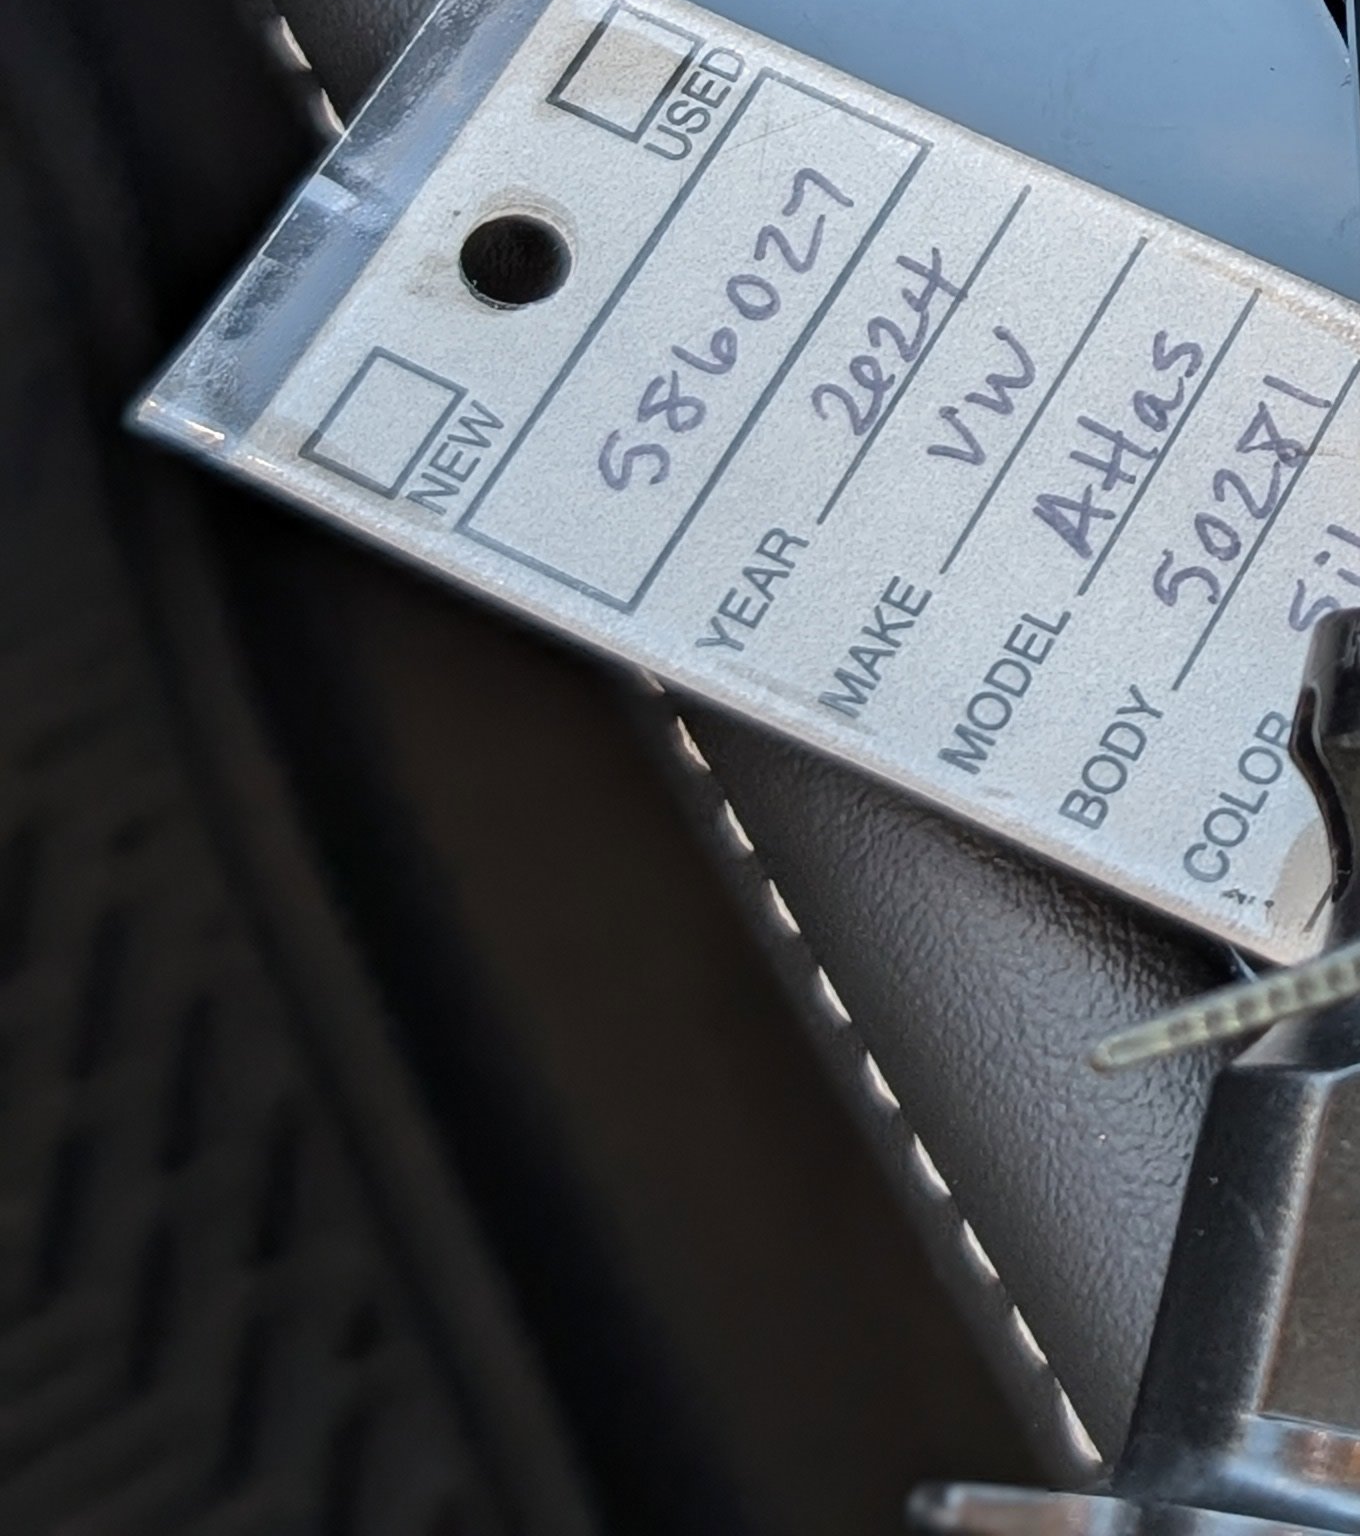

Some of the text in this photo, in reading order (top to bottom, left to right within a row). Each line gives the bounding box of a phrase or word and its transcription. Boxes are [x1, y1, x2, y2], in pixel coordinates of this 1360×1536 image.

[643, 45, 748, 164] USED
[599, 166, 855, 492] 586027
[811, 245, 969, 438] 2024
[928, 324, 1037, 467] VW
[405, 398, 506, 517] NEW
[1032, 328, 1202, 561] Atlas
[1152, 373, 1333, 608] 50281
[695, 525, 811, 655] YEAR
[817, 574, 935, 721] MAKE
[937, 608, 1073, 778] MODEL
[1057, 684, 1166, 833] BODY
[1182, 710, 1293, 884] COLOR
